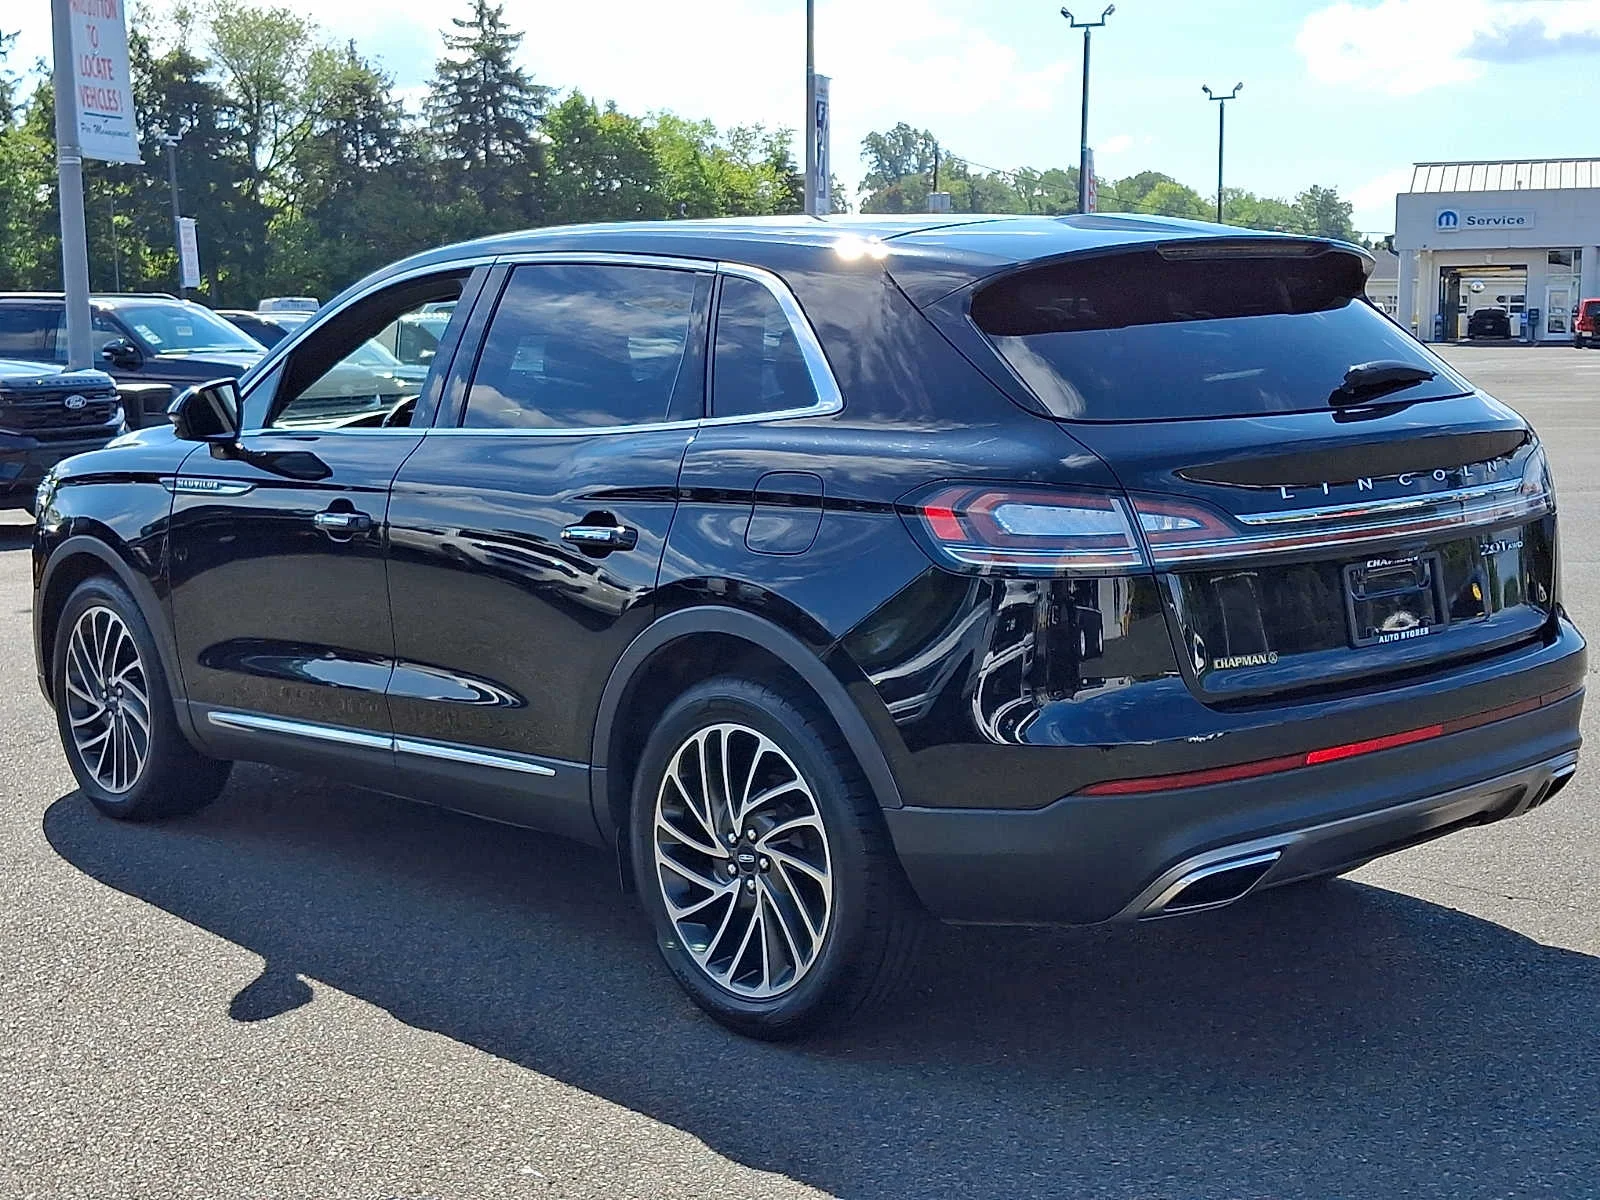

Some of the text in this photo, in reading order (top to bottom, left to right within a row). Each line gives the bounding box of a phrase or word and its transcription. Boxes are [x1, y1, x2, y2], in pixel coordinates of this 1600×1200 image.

[86, 23, 98, 49] TO
[80, 54, 114, 80] LOCATE
[80, 85, 123, 112] VEHICLES!
[1466, 215, 1526, 226] Service
[1280, 460, 1498, 499] LINCOLN
[1378, 633, 1399, 643] AUTO
[1213, 654, 1267, 669] CHAPMAN
